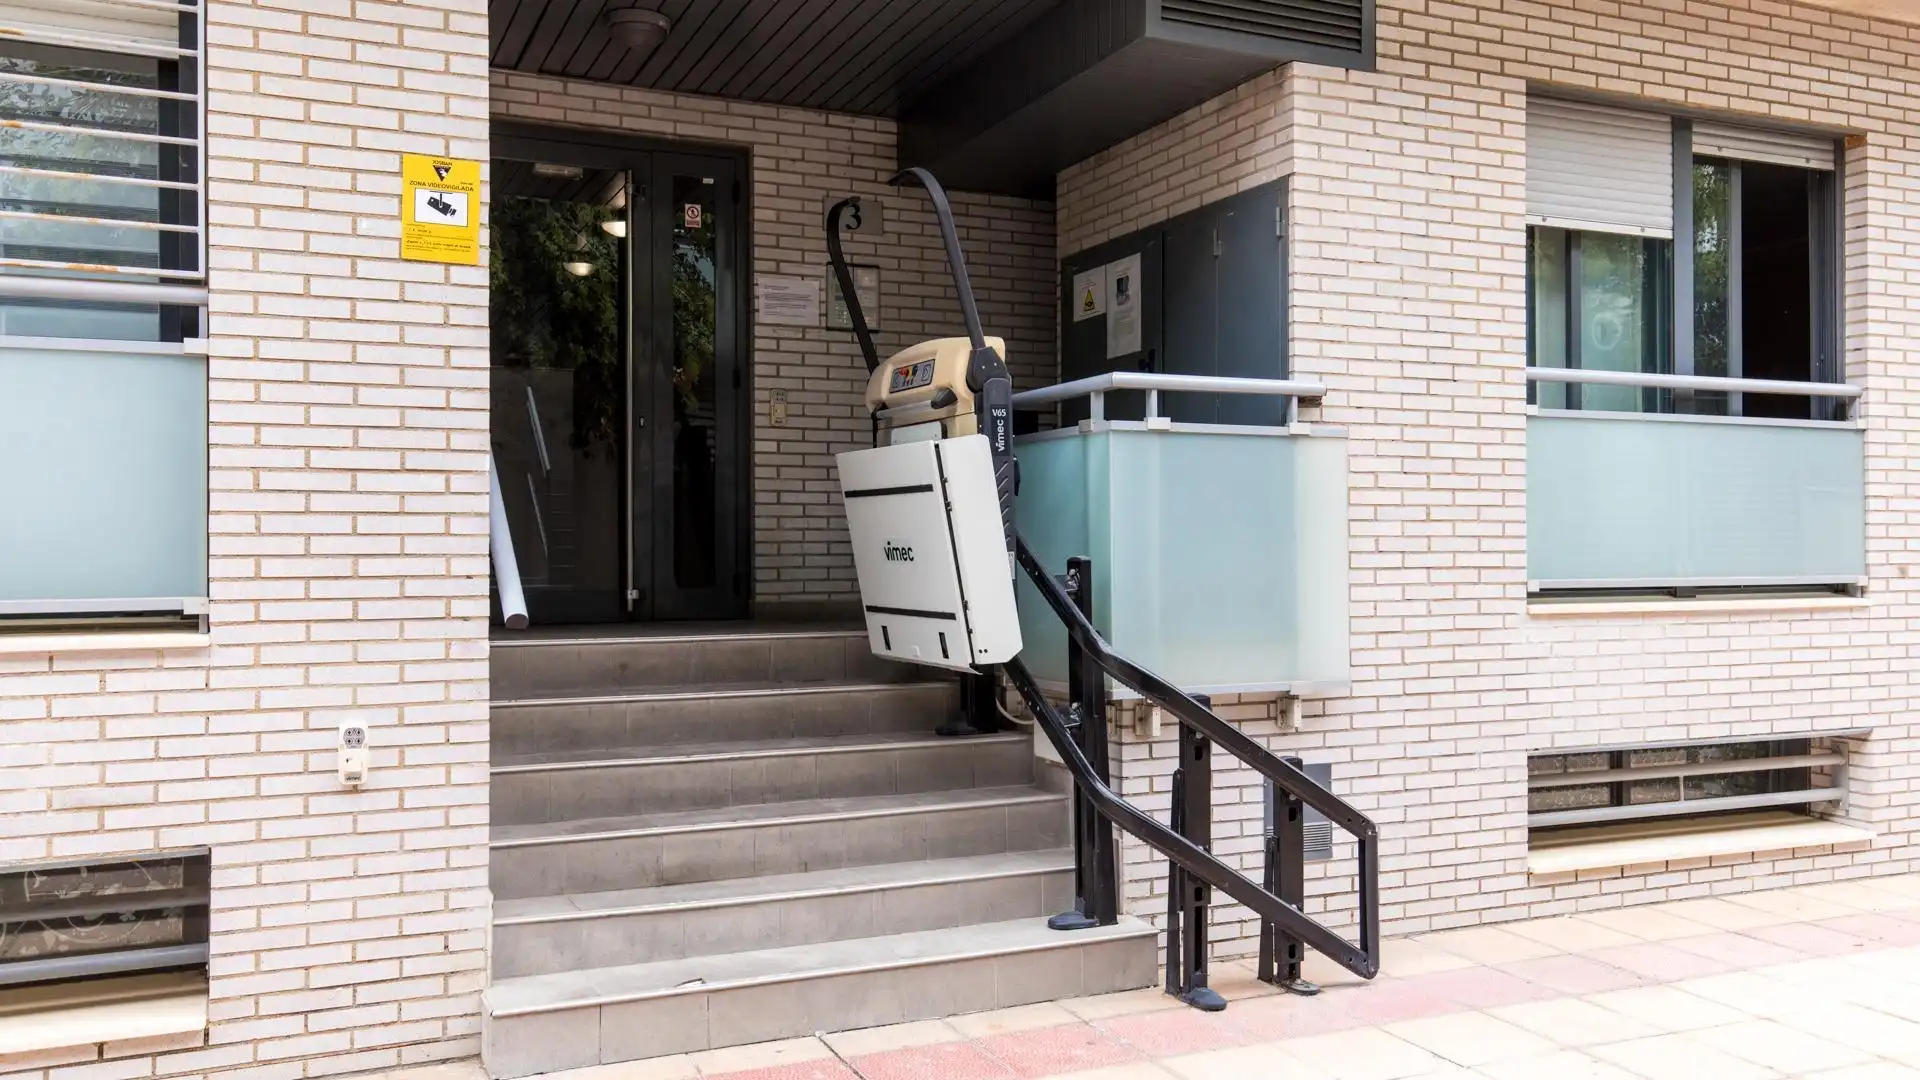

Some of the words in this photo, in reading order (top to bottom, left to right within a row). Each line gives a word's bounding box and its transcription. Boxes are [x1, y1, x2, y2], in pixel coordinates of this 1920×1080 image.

[427, 182, 474, 192] VIDEOVIGILADA
[845, 203, 862, 230] 3
[996, 419, 1005, 452] vimec
[884, 541, 914, 561] vimec
